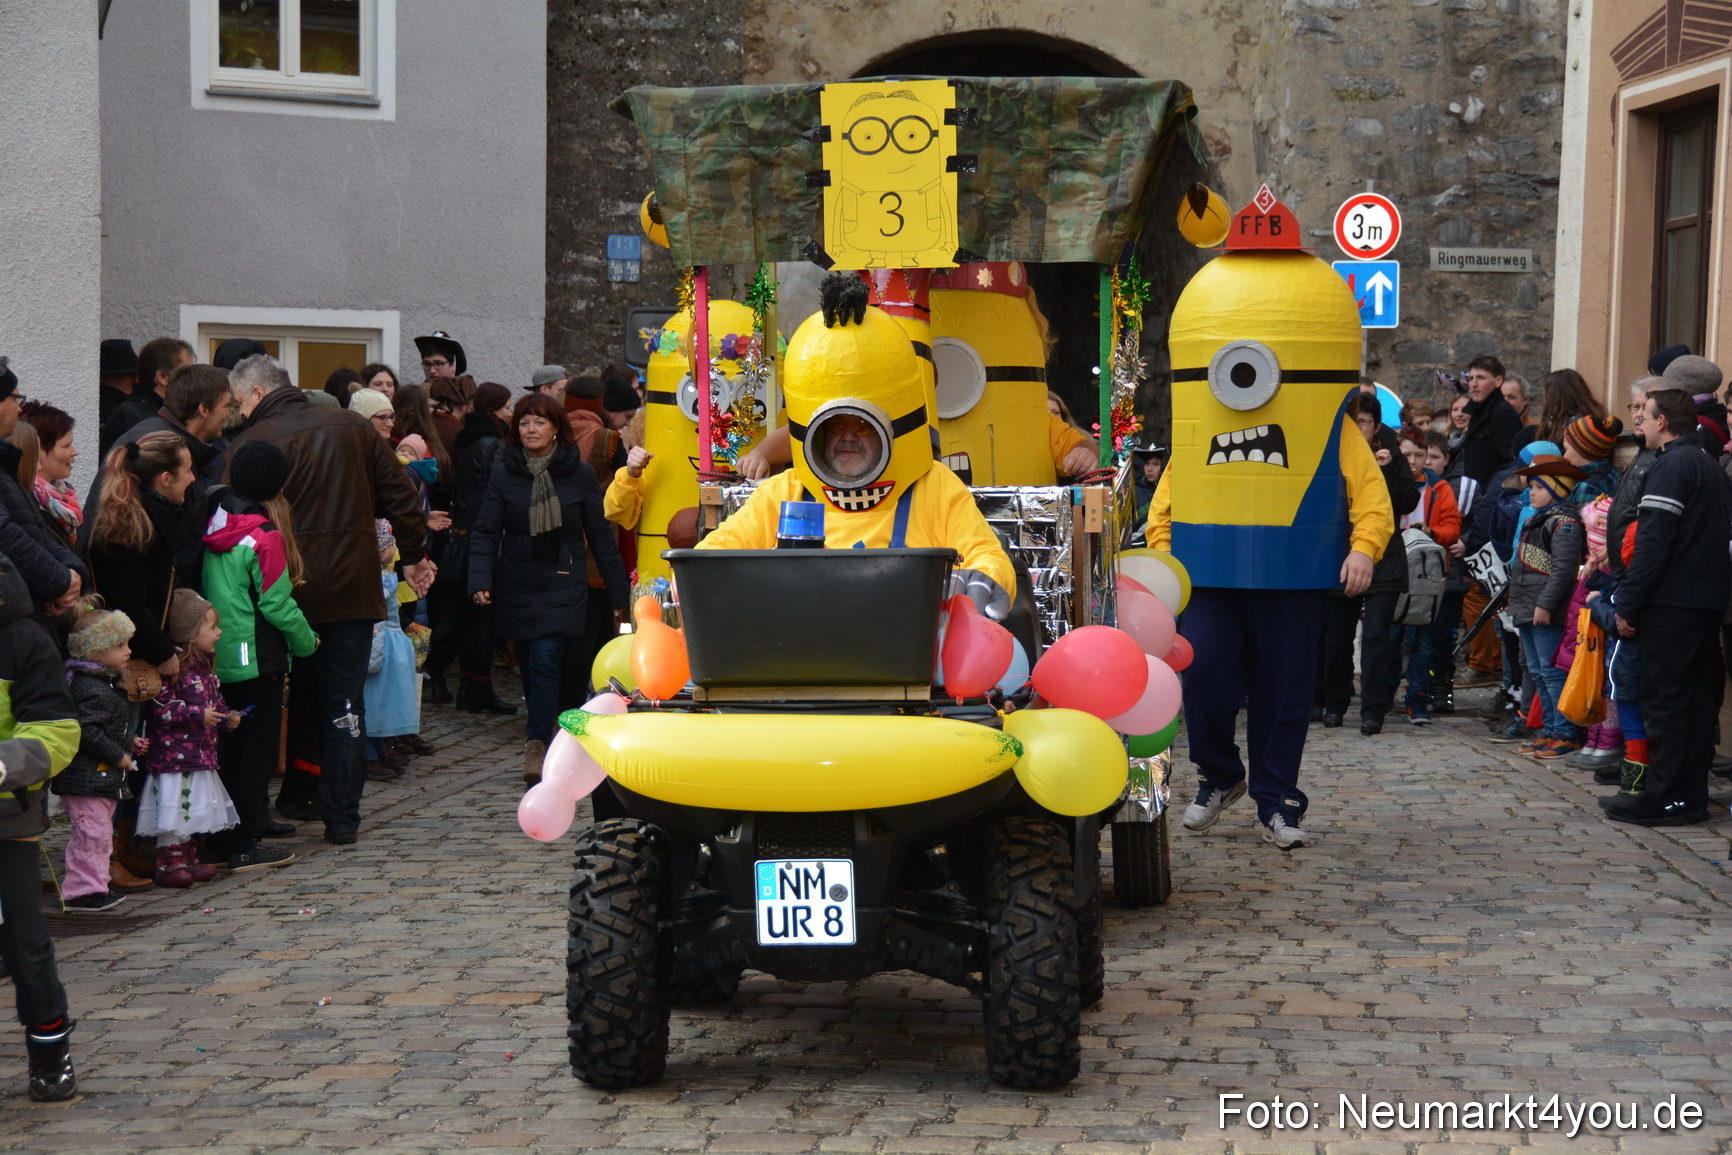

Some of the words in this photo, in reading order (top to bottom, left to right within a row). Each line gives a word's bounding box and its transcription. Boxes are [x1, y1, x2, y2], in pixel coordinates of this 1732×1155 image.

[1259, 189, 1269, 207] 3
[879, 191, 905, 237] 3
[1240, 215, 1282, 236] FFB
[1352, 213, 1365, 240] 3
[1367, 225, 1383, 240] m
[1438, 251, 1527, 270] Ringmauerweg
[763, 886, 773, 897] D
[779, 867, 827, 900] NM
[767, 905, 815, 939] UR
[824, 904, 845, 938] 8
